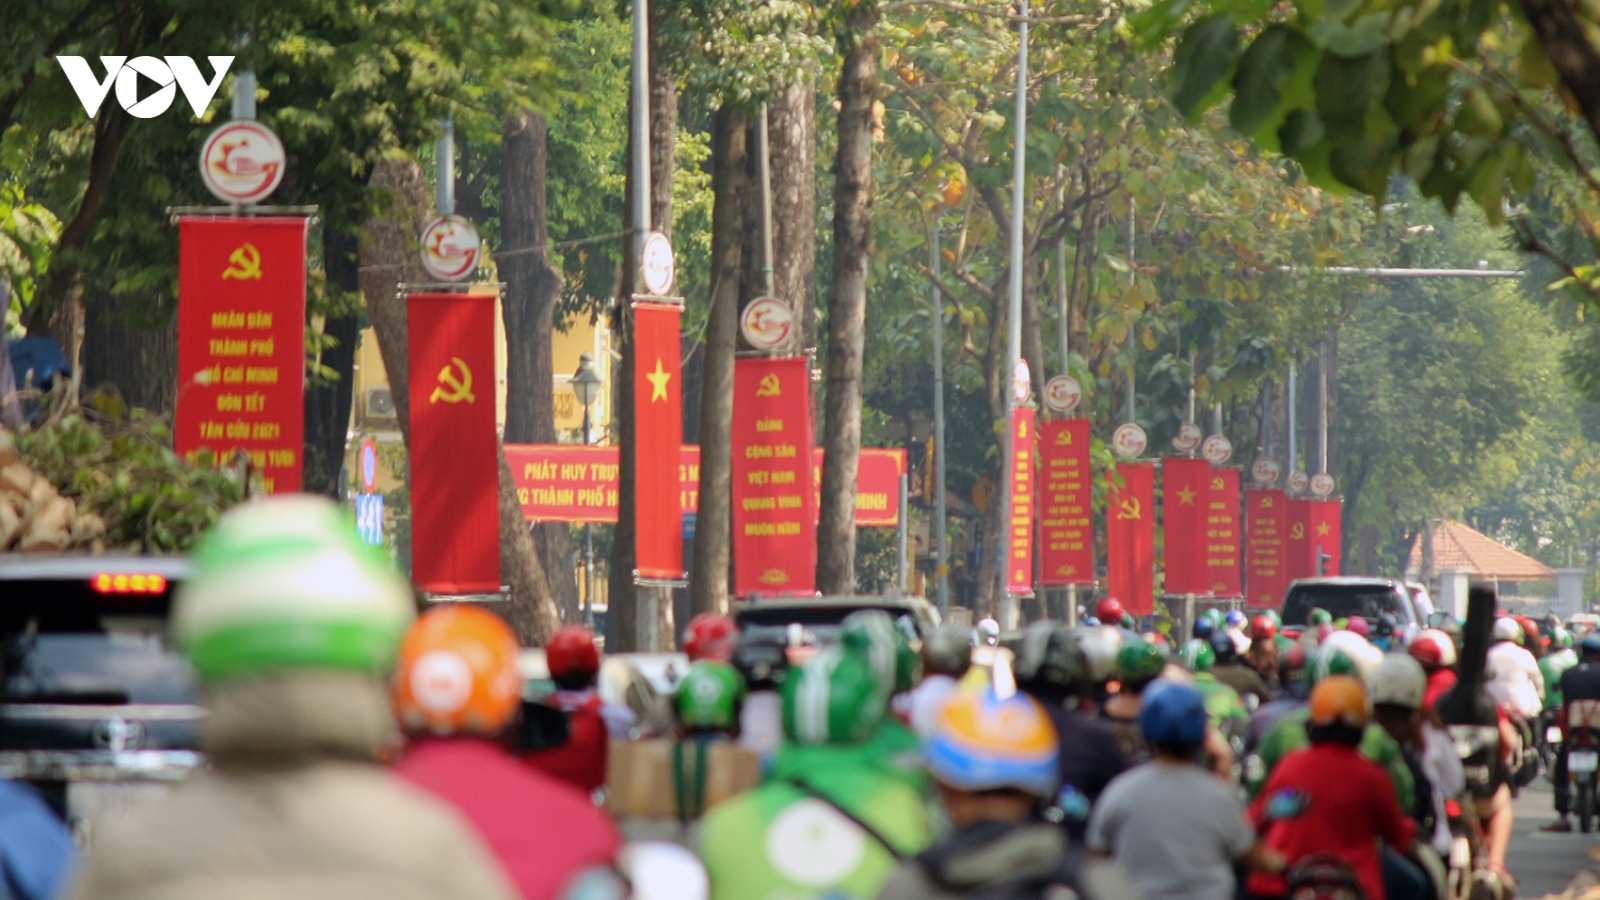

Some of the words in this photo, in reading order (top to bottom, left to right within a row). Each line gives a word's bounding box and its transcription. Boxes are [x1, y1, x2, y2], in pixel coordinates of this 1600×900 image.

[209, 337, 248, 356] THÀNH
[250, 335, 274, 356] PHỐ
[246, 366, 278, 383] MINH
[252, 422, 279, 439] 2021
[525, 459, 558, 480] PHÁT
[561, 464, 587, 481] HUY
[532, 485, 574, 506] THÀNH
[578, 484, 605, 506] PHỐ
[855, 493, 887, 510] MINH
